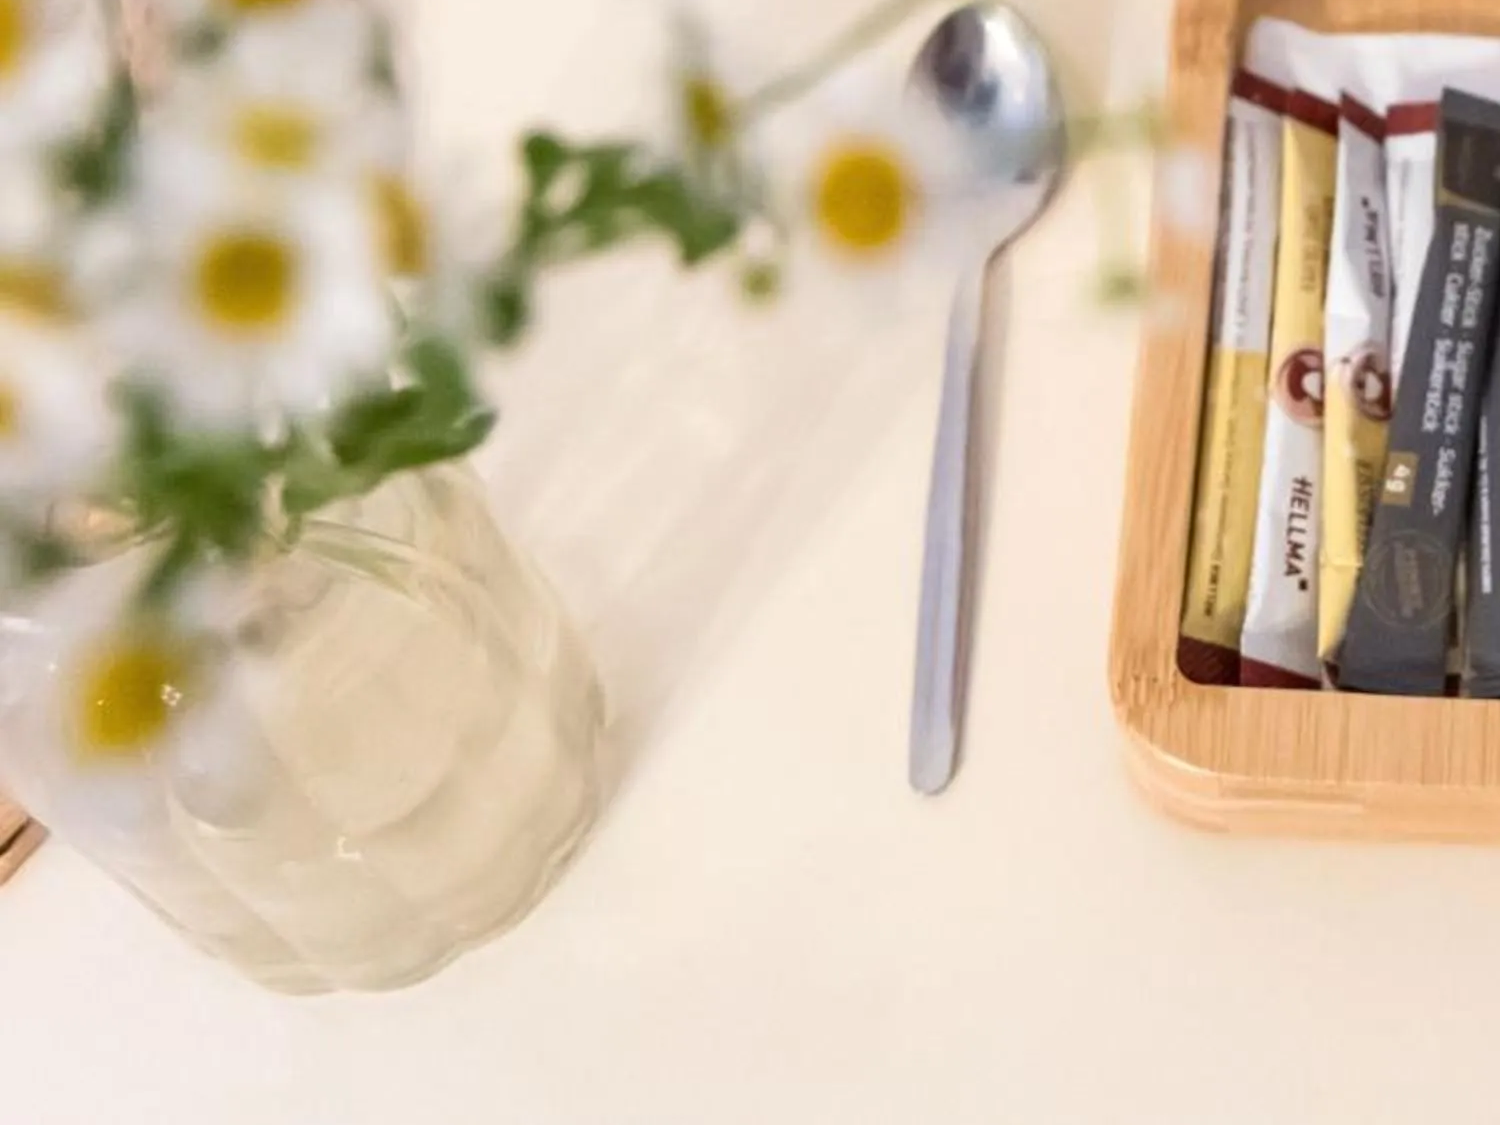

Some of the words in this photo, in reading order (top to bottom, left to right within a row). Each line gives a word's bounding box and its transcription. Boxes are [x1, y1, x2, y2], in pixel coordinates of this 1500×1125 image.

[1451, 222, 1470, 261] stick
[1448, 340, 1474, 391] Sugar
[1443, 393, 1463, 436] stick
[1284, 475, 1313, 577] HELLMA
